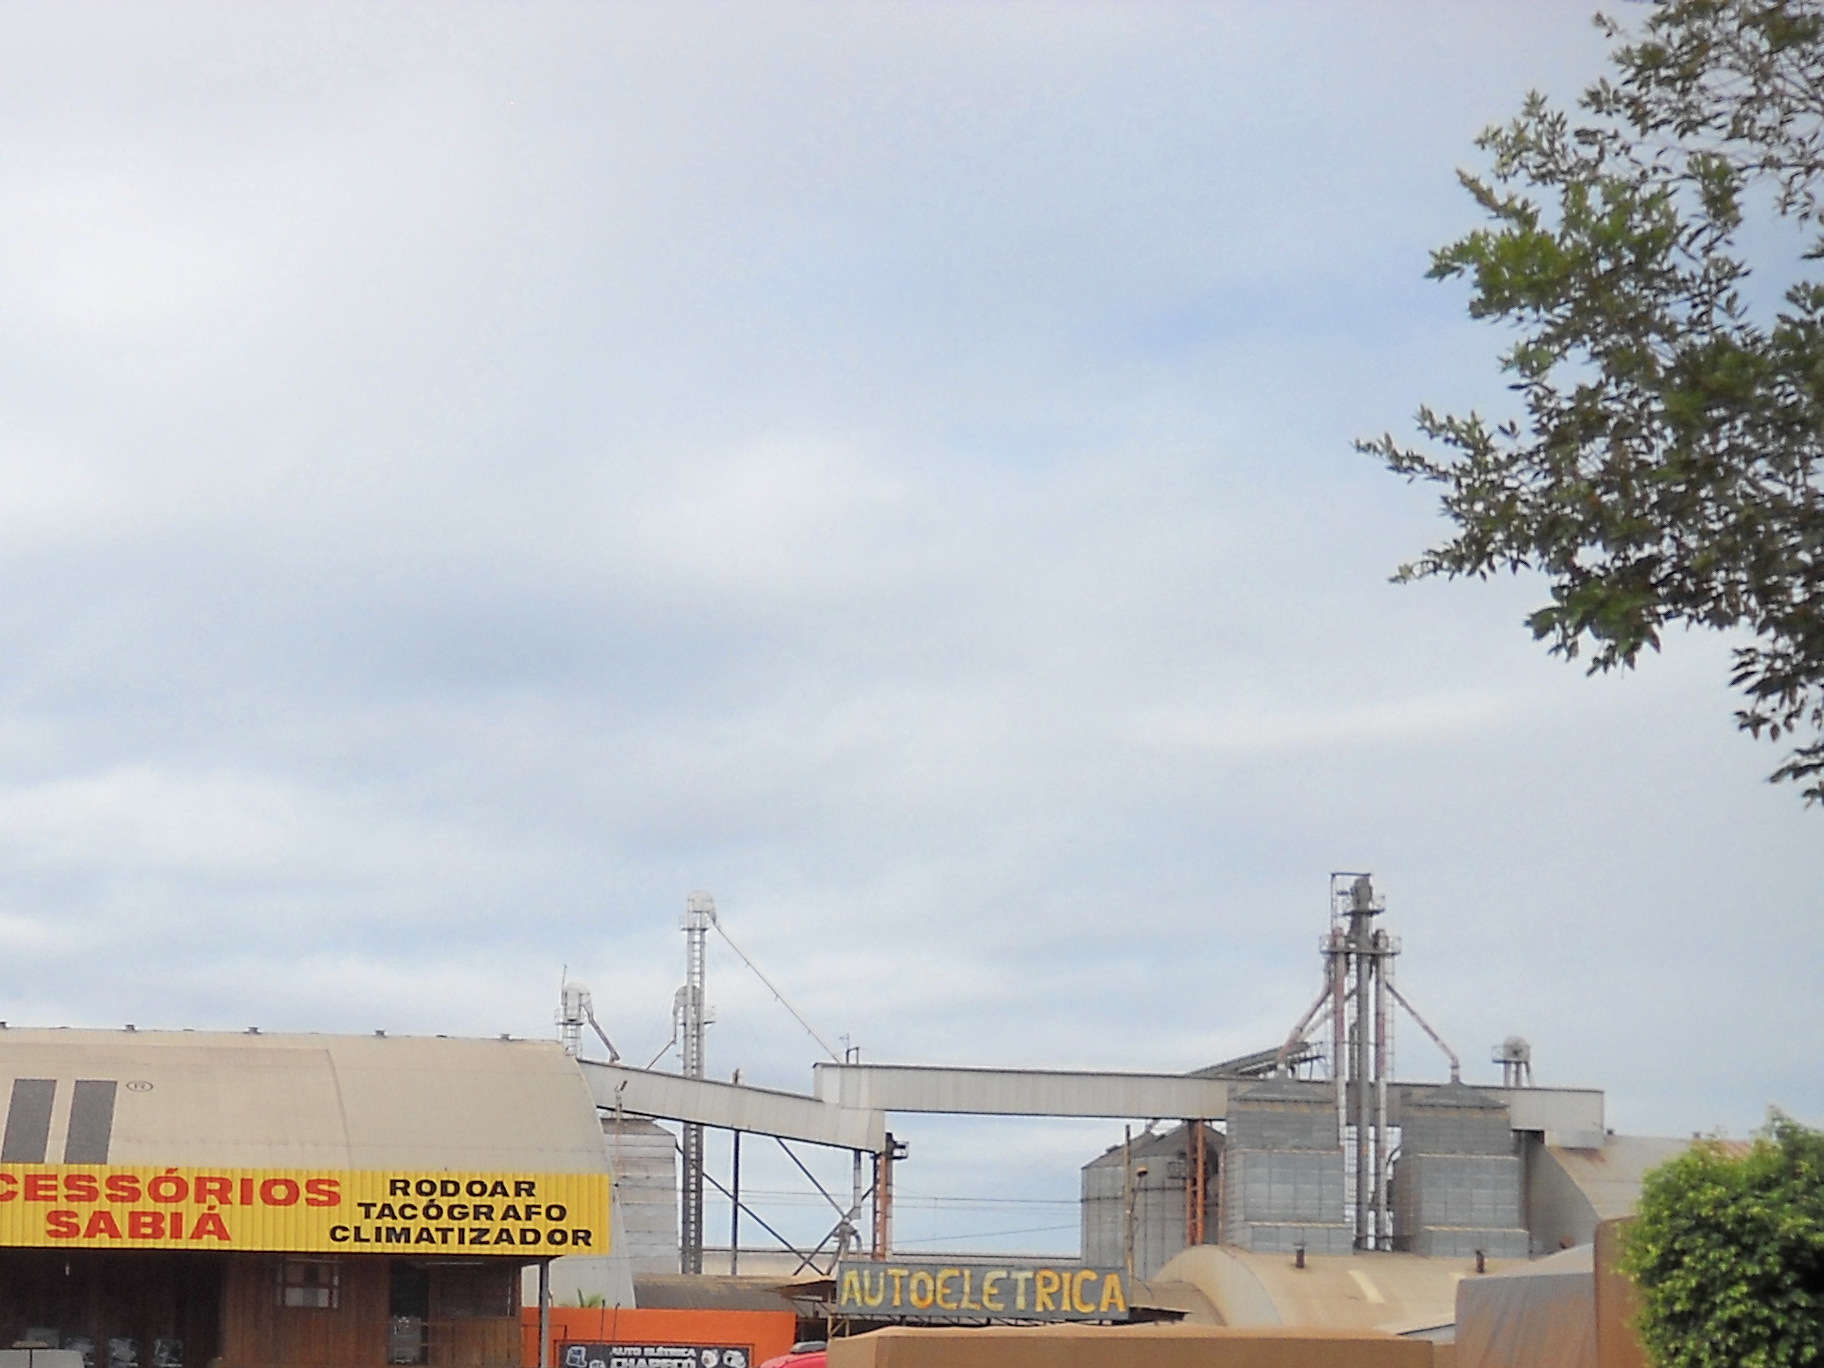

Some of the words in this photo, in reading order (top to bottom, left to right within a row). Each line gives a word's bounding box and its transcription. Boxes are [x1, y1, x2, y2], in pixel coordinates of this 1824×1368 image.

[389, 1178, 537, 1198] RODOAR
[357, 1198, 568, 1222] TACÓGRAFO
[45, 1205, 232, 1241] SABIÁ
[329, 1225, 593, 1247] CLIMATIZADOR
[840, 1267, 1127, 1314] AUTOELETRICA
[610, 1346, 642, 1357] AUTO
